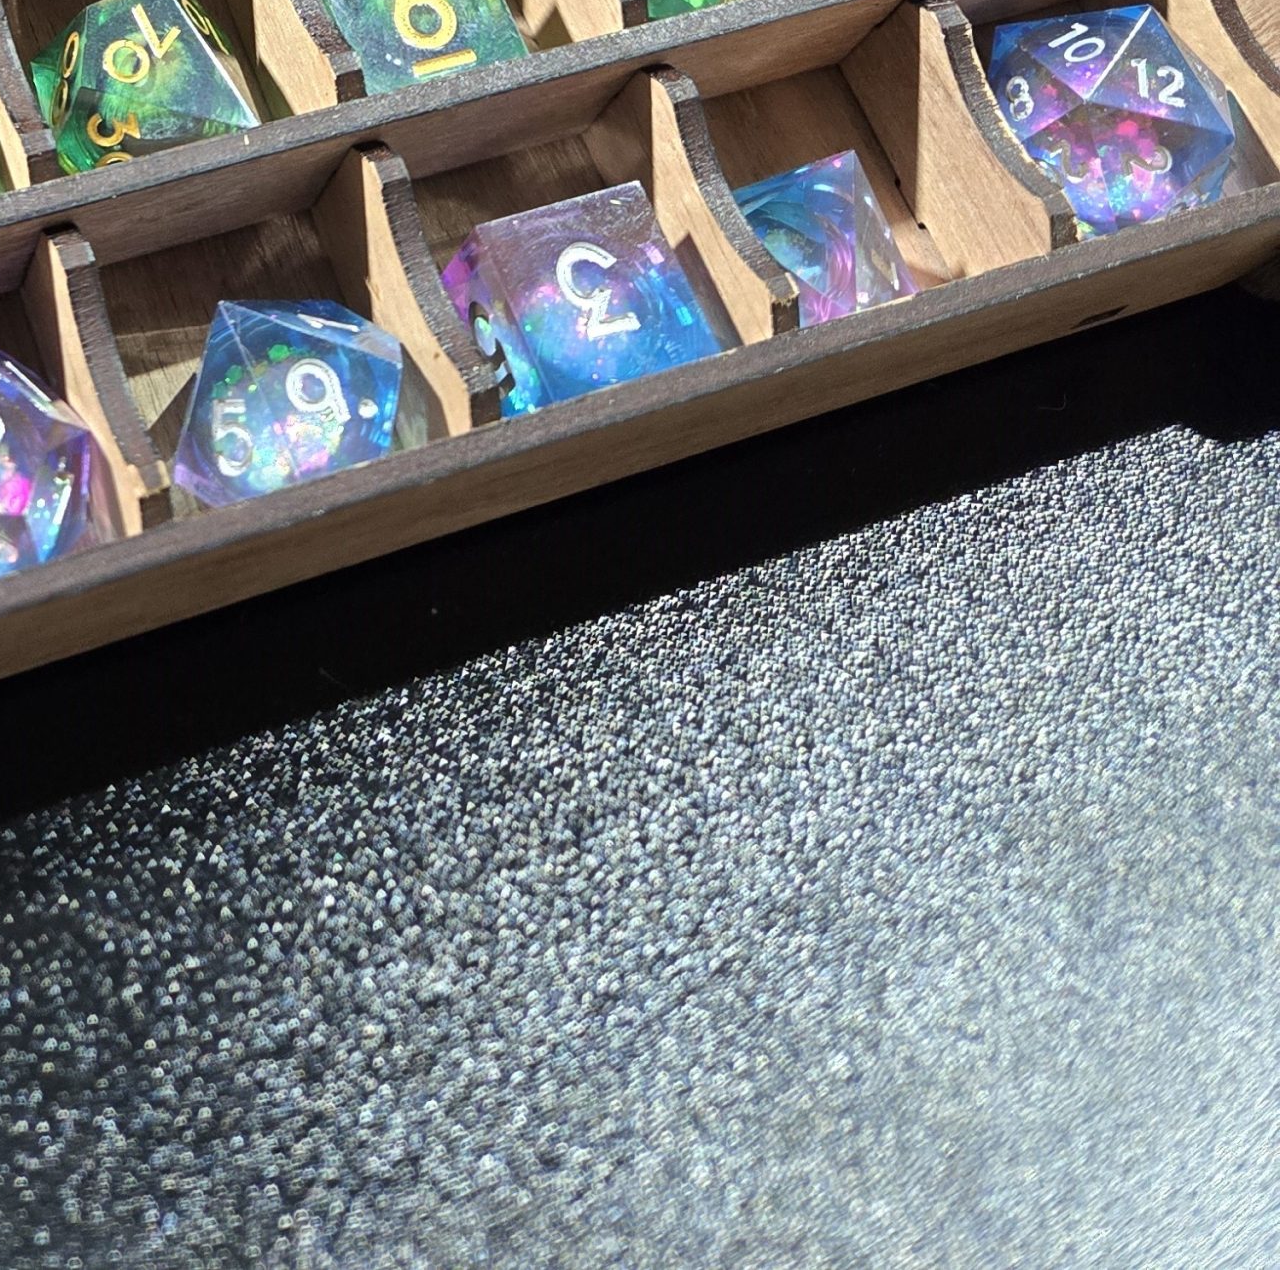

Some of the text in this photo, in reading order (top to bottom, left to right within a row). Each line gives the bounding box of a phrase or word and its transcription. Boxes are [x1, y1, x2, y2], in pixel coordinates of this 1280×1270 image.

[102, 4, 181, 84] 70
[1047, 22, 1106, 63] 10
[1130, 57, 1186, 109] 12
[555, 240, 642, 342] 3
[212, 397, 253, 477] 5
